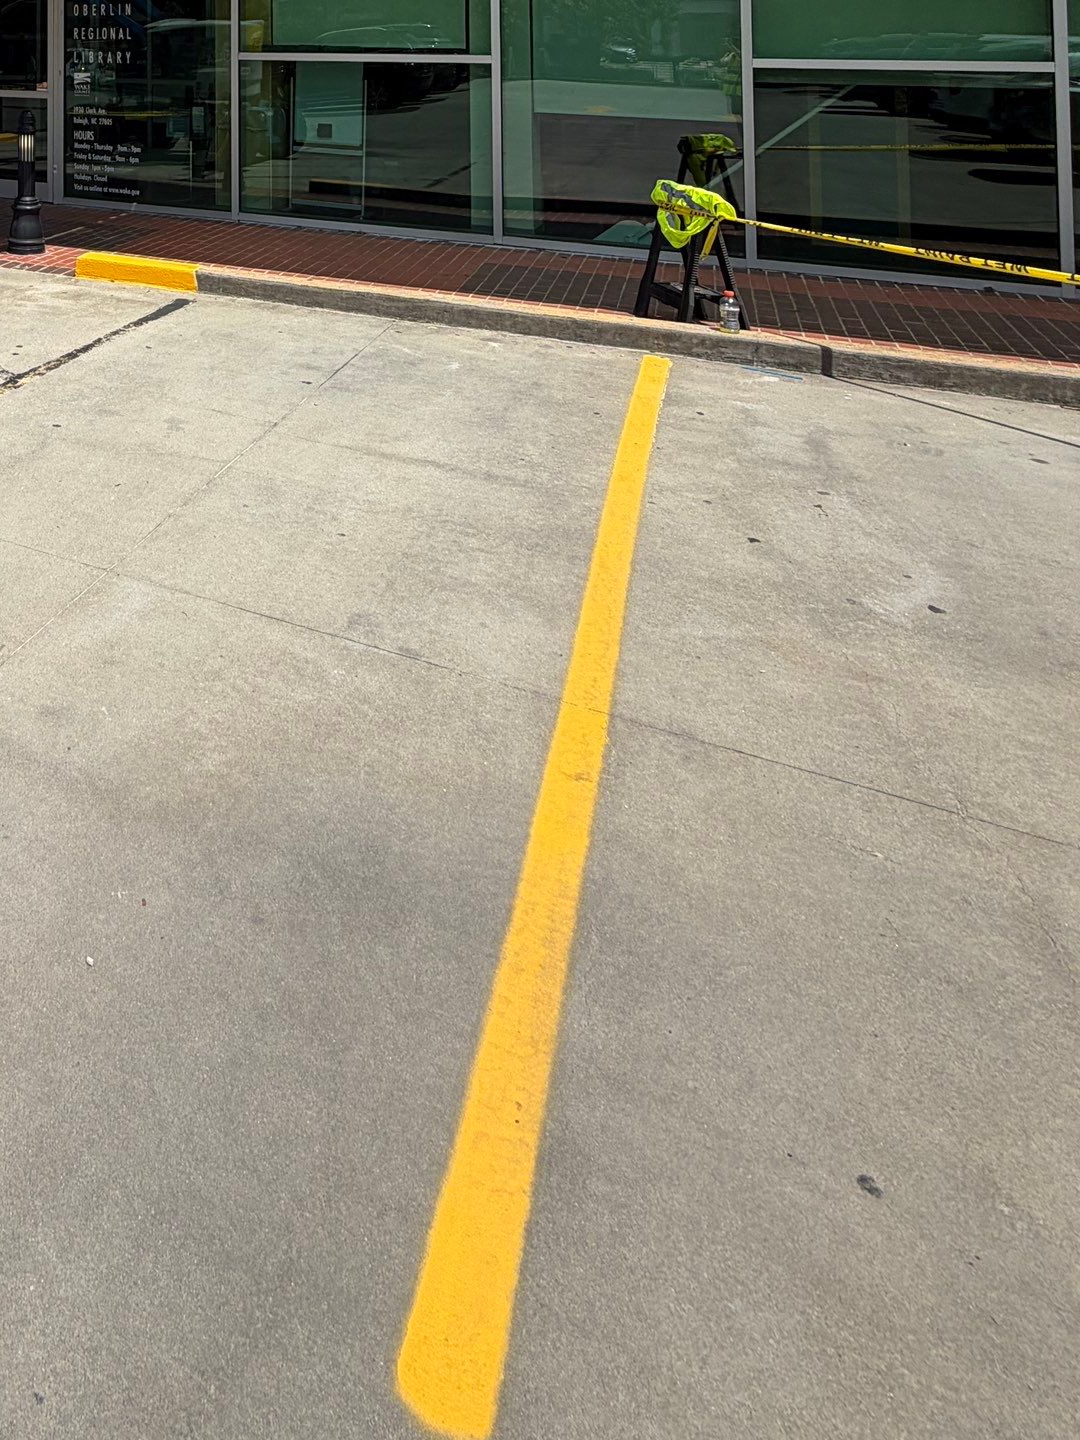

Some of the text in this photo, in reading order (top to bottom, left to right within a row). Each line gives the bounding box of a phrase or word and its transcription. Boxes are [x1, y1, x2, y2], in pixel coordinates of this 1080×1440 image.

[73, 4, 132, 16] OBERLIN
[73, 27, 132, 40] REGIONAL
[73, 51, 131, 64] LIBRARY
[74, 130, 94, 140] HOURS
